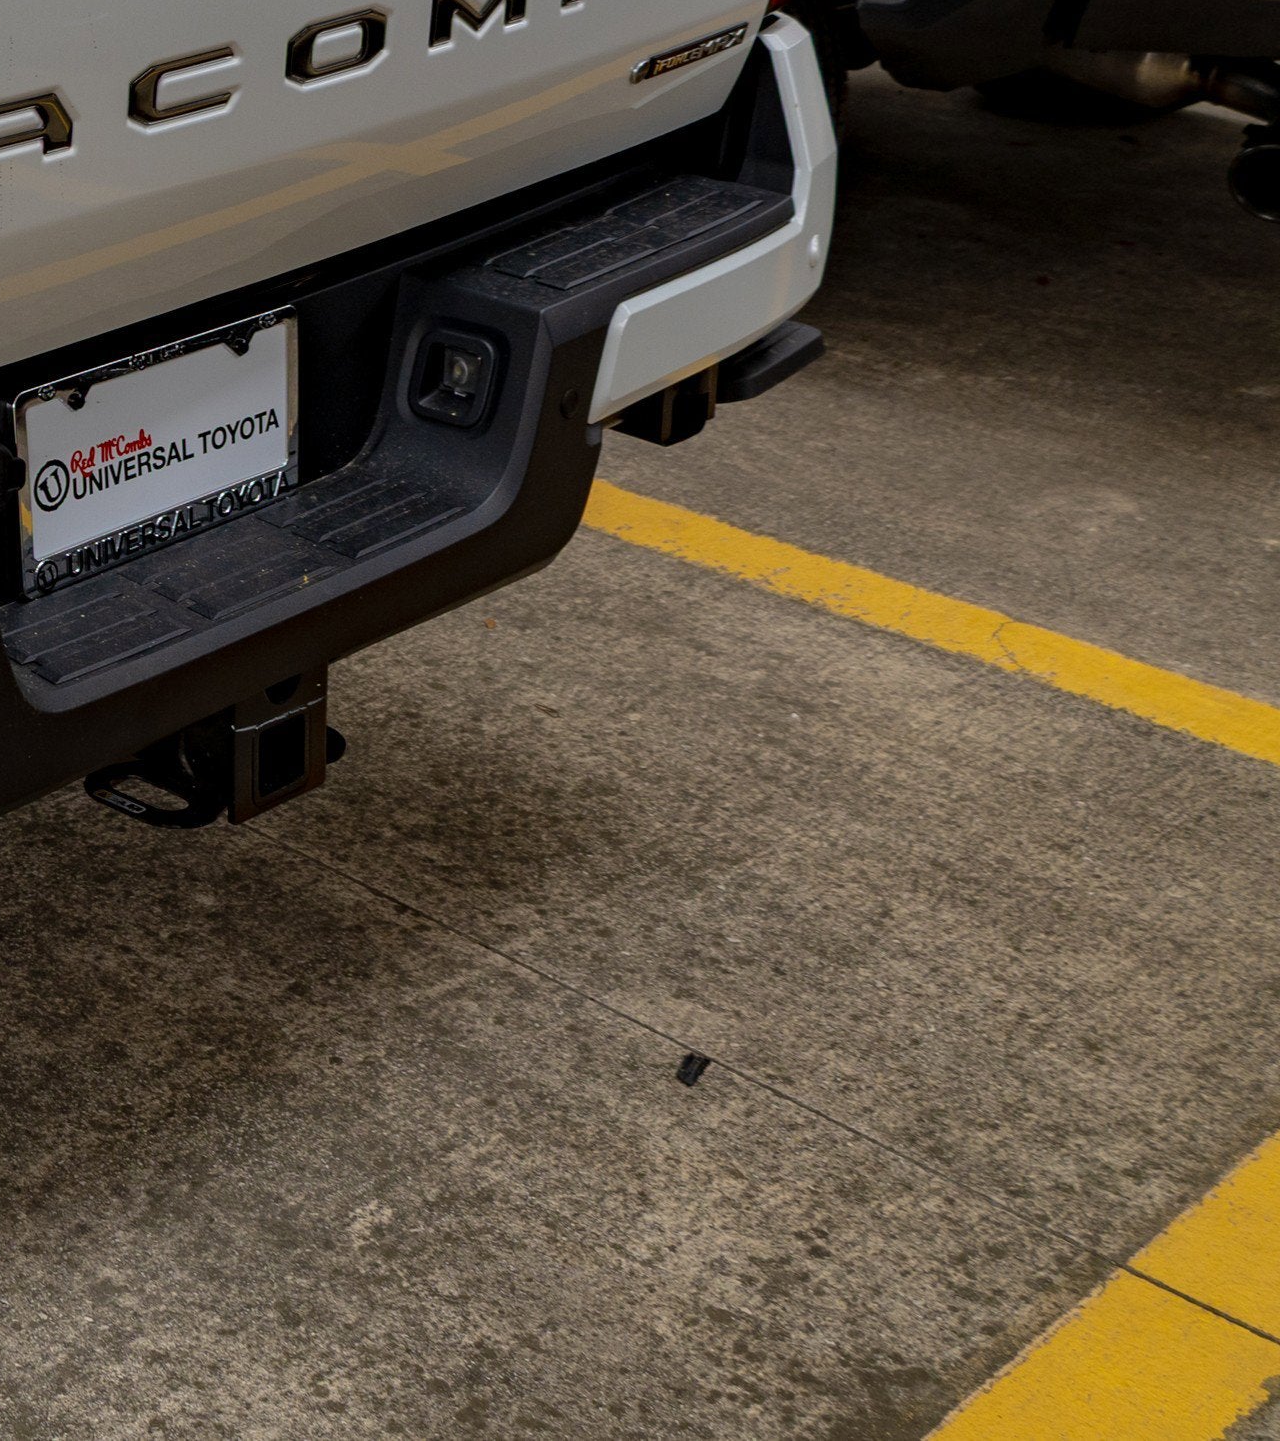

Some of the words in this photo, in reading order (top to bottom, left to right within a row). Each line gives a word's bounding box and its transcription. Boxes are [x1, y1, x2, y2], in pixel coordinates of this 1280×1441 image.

[70, 446, 96, 478] Red
[72, 438, 195, 500] UNIVERSAL
[198, 408, 280, 454] TOYOTA
[66, 505, 202, 578] UNIVERSAL
[203, 470, 290, 519] TOYOTA
